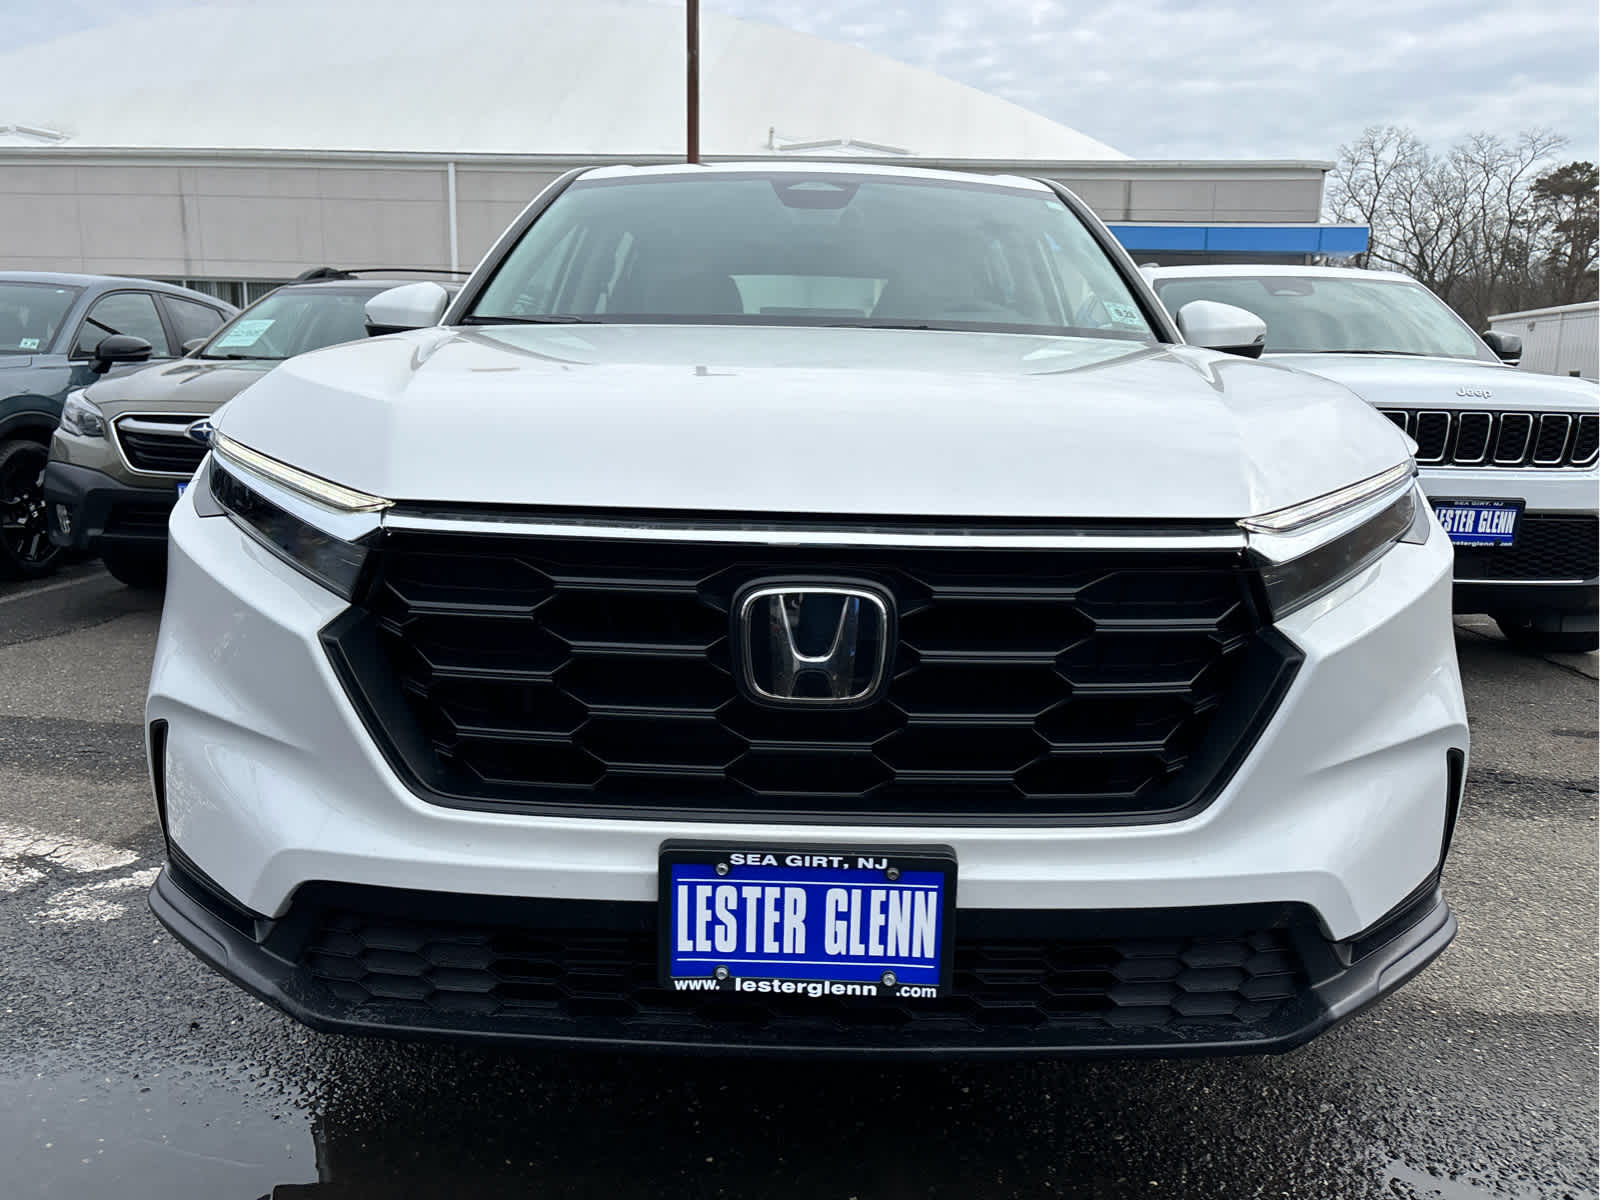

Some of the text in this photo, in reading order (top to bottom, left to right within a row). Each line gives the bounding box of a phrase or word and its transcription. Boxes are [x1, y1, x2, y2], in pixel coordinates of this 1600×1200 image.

[1455, 385, 1493, 400] Jeep
[1477, 510, 1517, 534] GLENN
[729, 853, 889, 870] SEA GIRT, NJ
[676, 884, 937, 959] LESTER GLENN
[674, 977, 937, 999] www. lesterglenn .com
